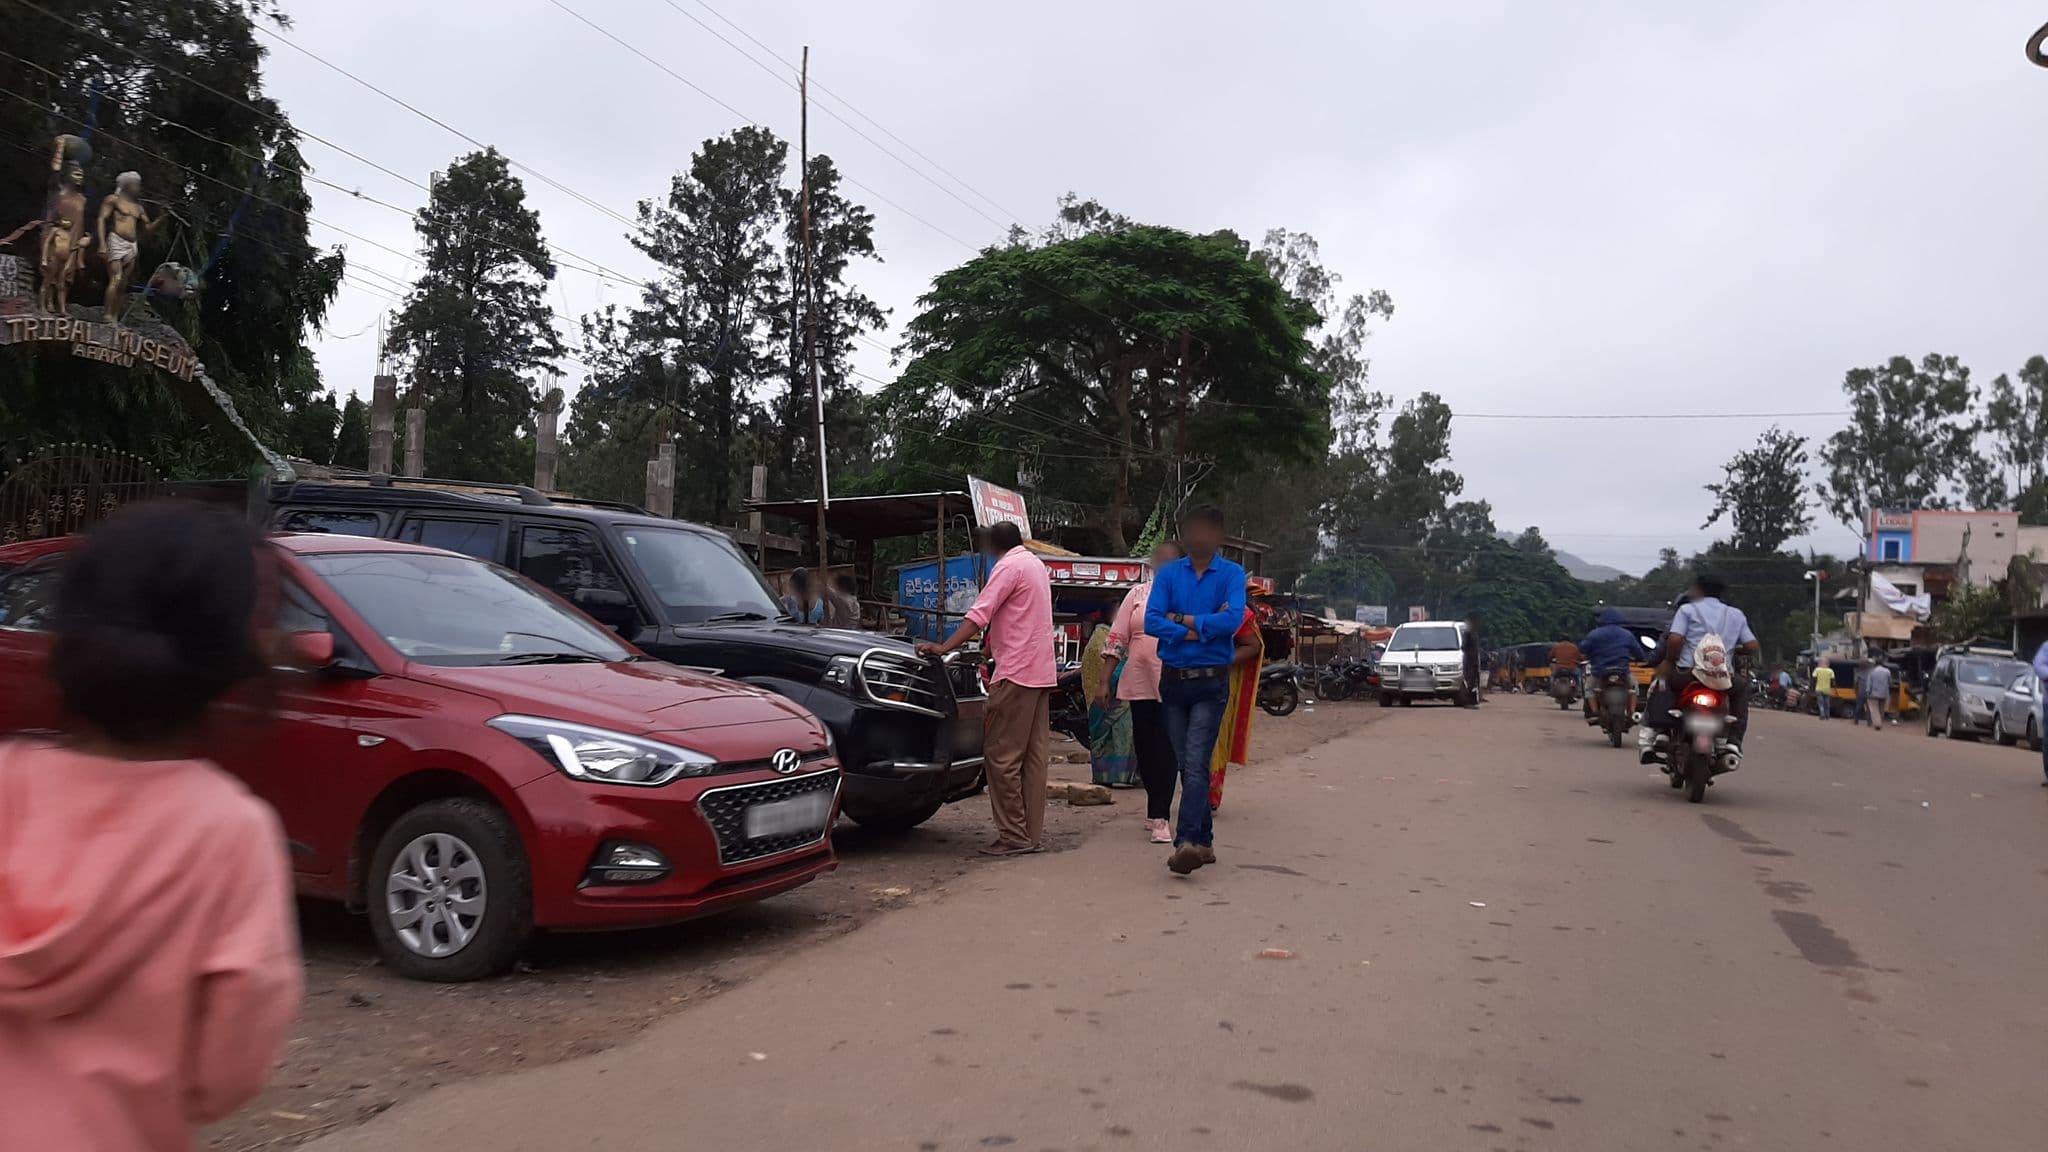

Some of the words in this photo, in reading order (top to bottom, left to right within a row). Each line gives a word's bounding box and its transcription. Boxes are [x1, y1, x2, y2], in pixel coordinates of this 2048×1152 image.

[6, 318, 101, 345] TRIBAL
[113, 330, 196, 383] MUSEUM
[72, 342, 134, 368] ARAKU
